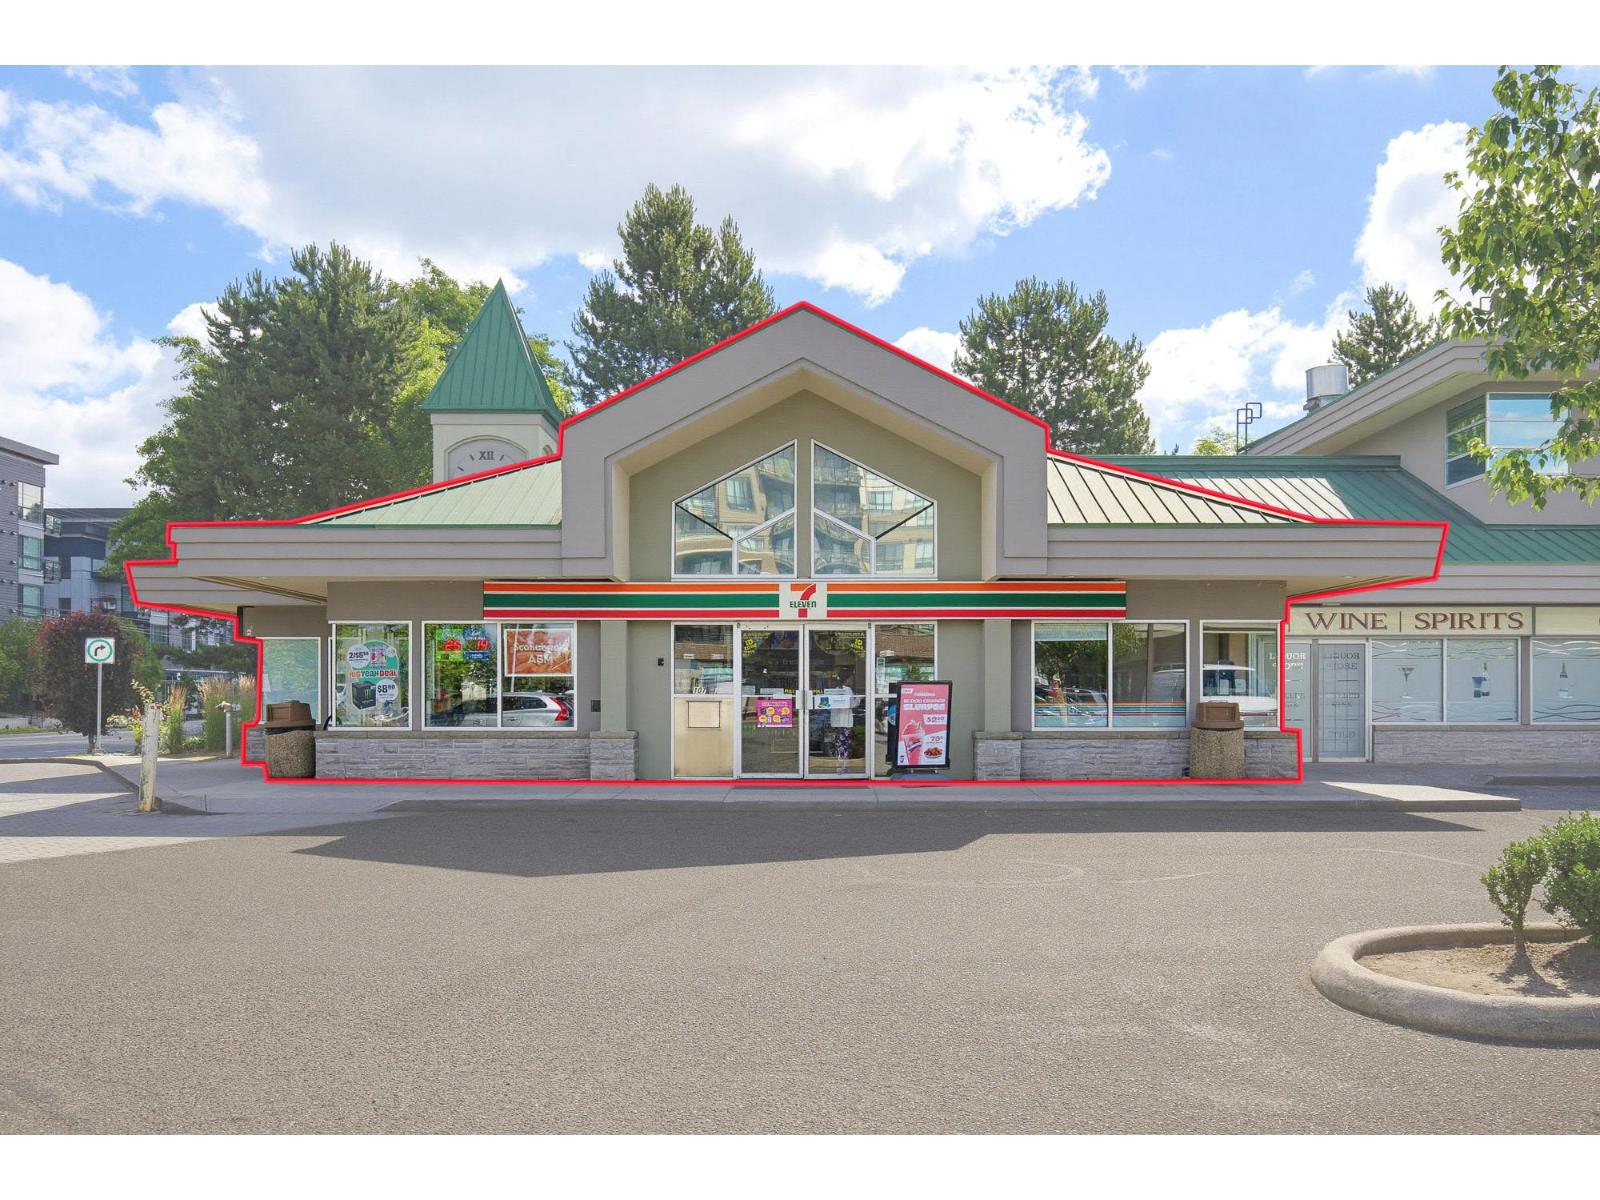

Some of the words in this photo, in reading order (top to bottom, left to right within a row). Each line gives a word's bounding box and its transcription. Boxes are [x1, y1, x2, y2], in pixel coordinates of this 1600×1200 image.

[479, 450, 495, 461] XII
[1306, 612, 1388, 631] WINE
[1414, 611, 1524, 630] SPIRITS
